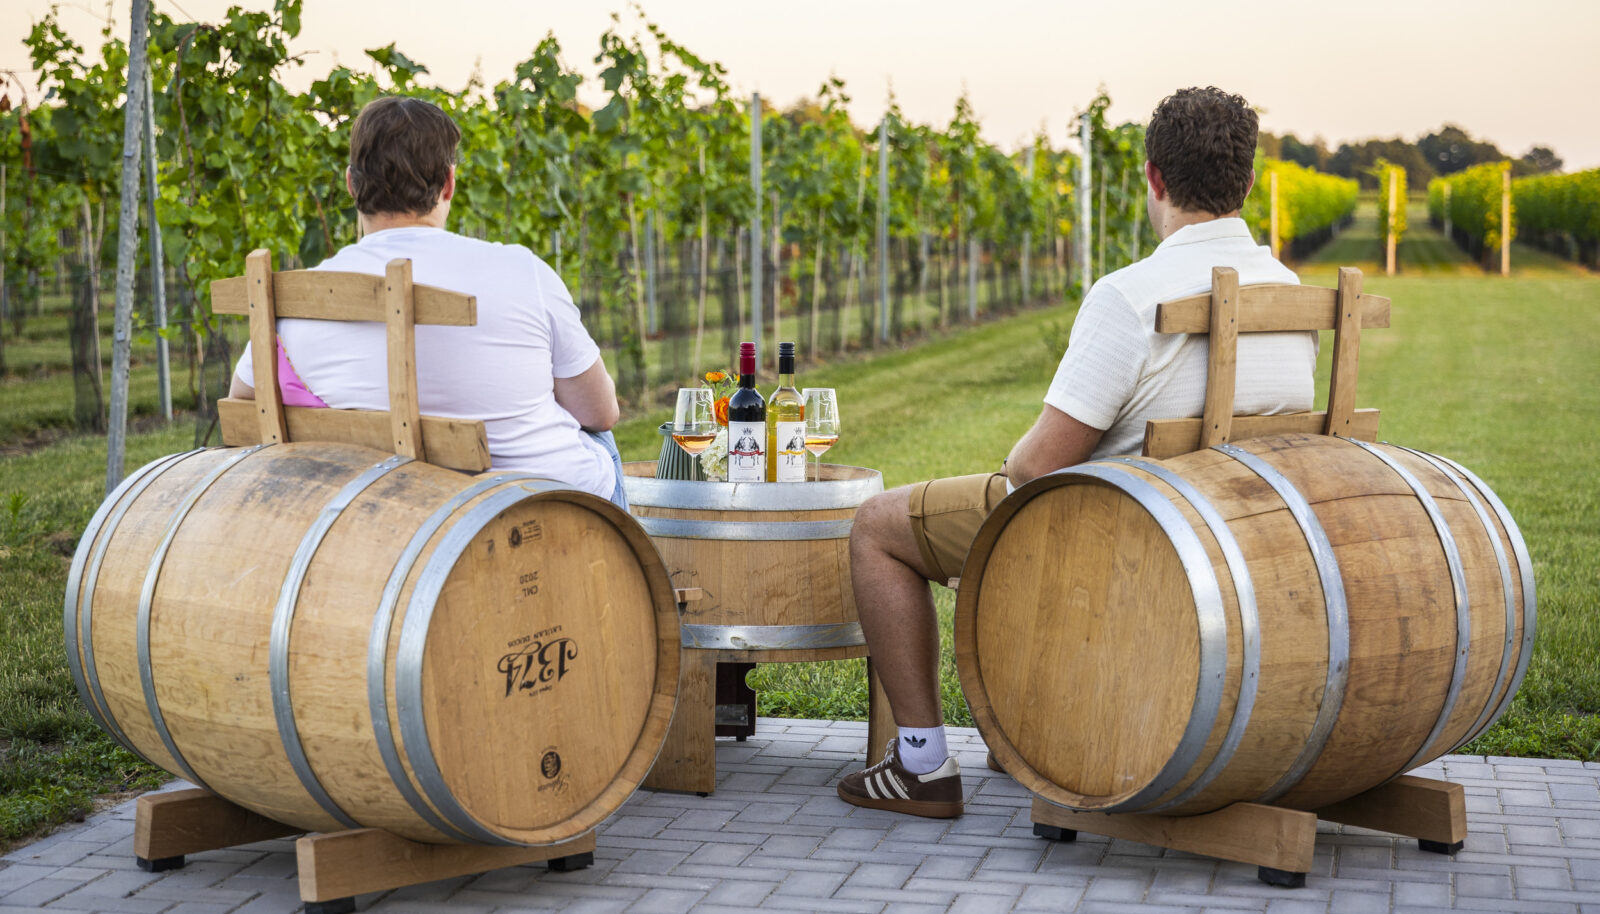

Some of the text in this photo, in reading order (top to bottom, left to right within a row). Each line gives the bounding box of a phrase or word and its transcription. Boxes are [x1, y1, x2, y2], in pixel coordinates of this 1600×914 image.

[519, 571, 539, 584] 2020
[533, 625, 563, 639] LAULAN
[497, 637, 578, 698] 1374
